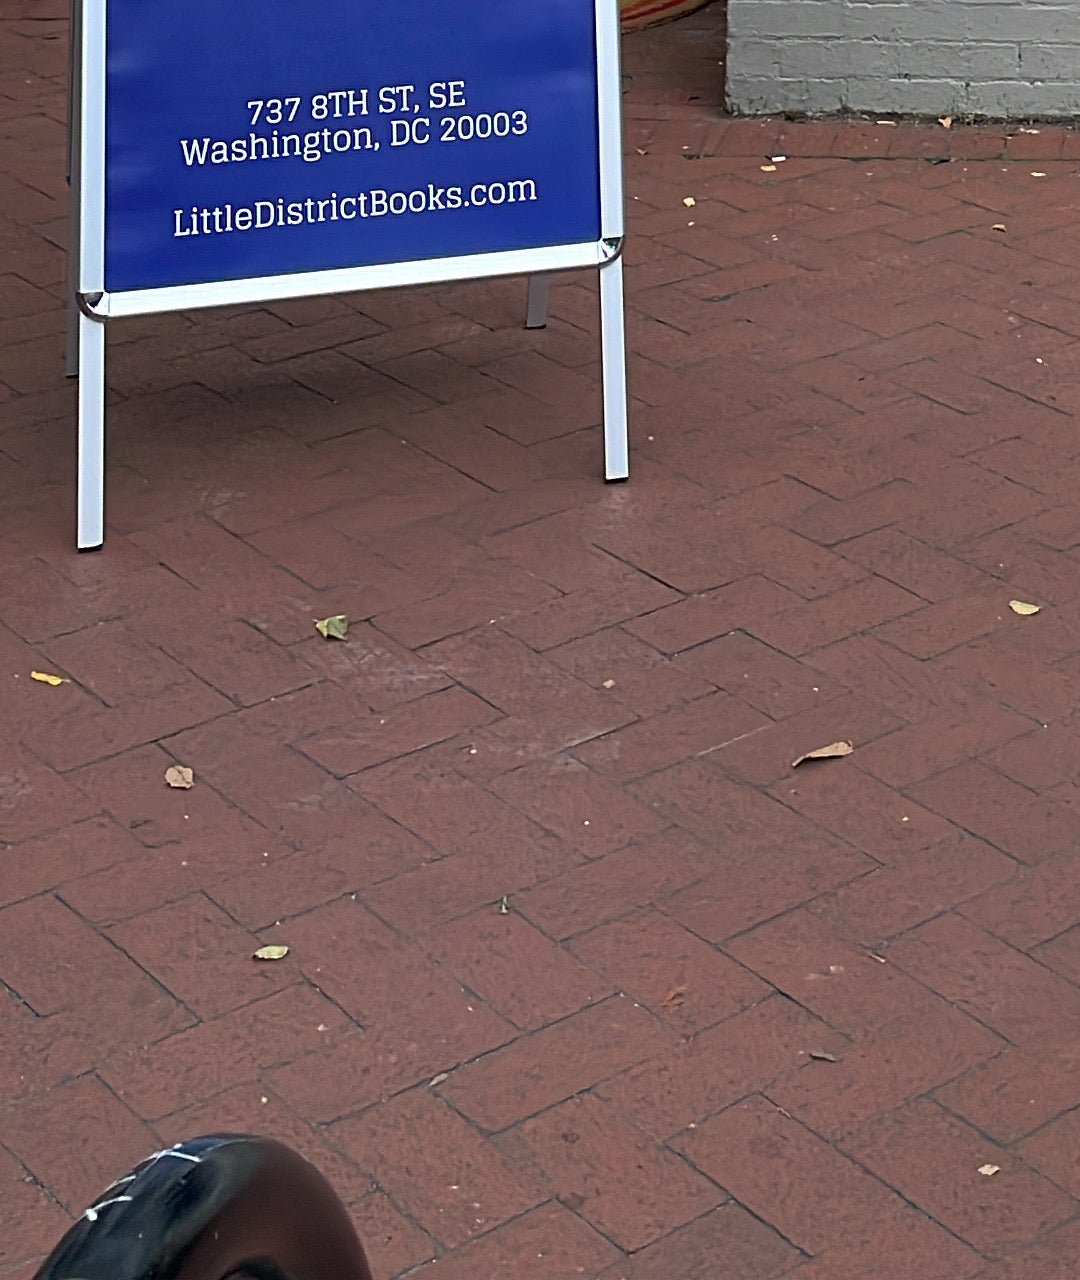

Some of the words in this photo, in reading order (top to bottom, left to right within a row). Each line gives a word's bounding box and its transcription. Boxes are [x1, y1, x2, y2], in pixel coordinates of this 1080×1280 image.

[248, 94, 301, 125] 737
[311, 89, 369, 120] 8TH
[379, 85, 420, 114] ST,
[430, 80, 466, 109] SE
[181, 127, 380, 166] Washington,
[391, 117, 430, 147] DC
[440, 110, 528, 142] 20003
[173, 179, 537, 237] LittleDistrictBooks.com
